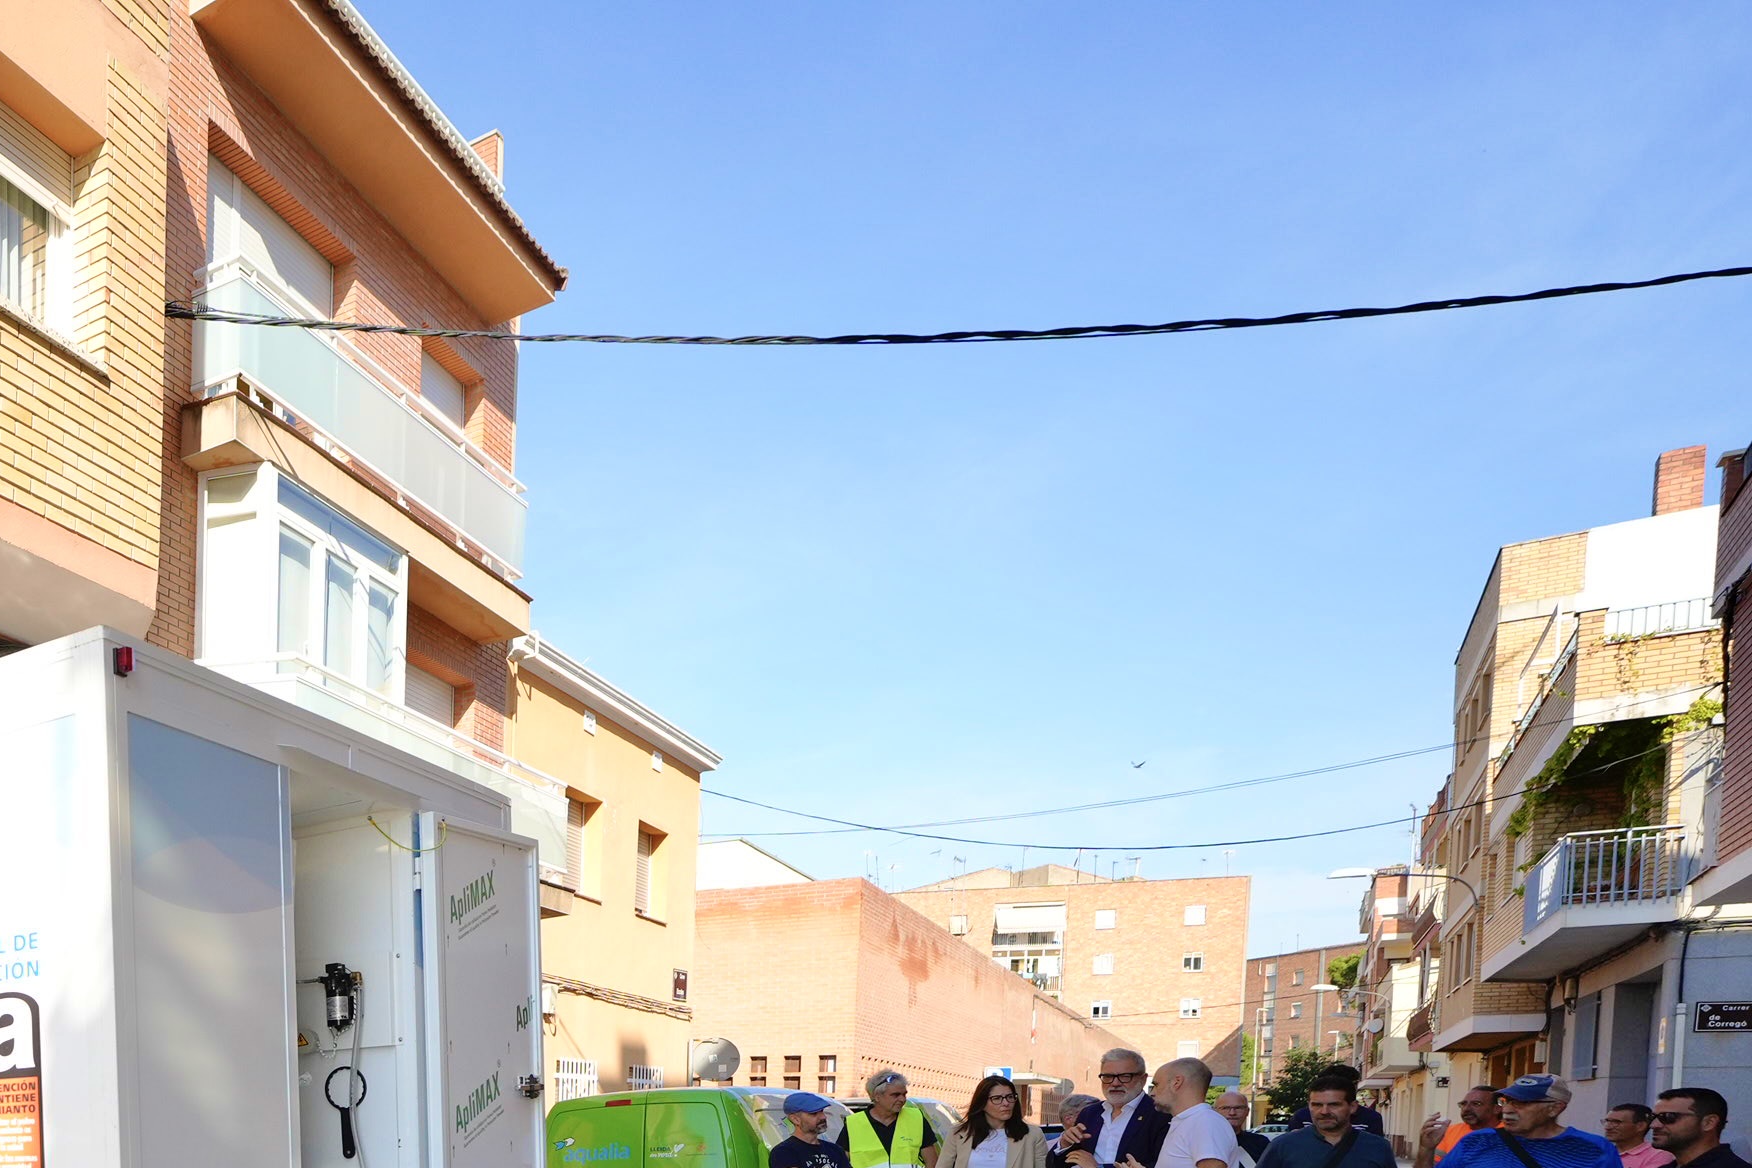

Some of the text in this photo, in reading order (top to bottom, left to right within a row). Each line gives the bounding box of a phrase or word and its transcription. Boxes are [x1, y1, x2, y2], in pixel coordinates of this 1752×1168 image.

[450, 869, 496, 925] ApliMAX
[13, 931, 38, 951] DE
[455, 1070, 501, 1134] ApliMAX
[563, 1142, 631, 1165] aqualia
